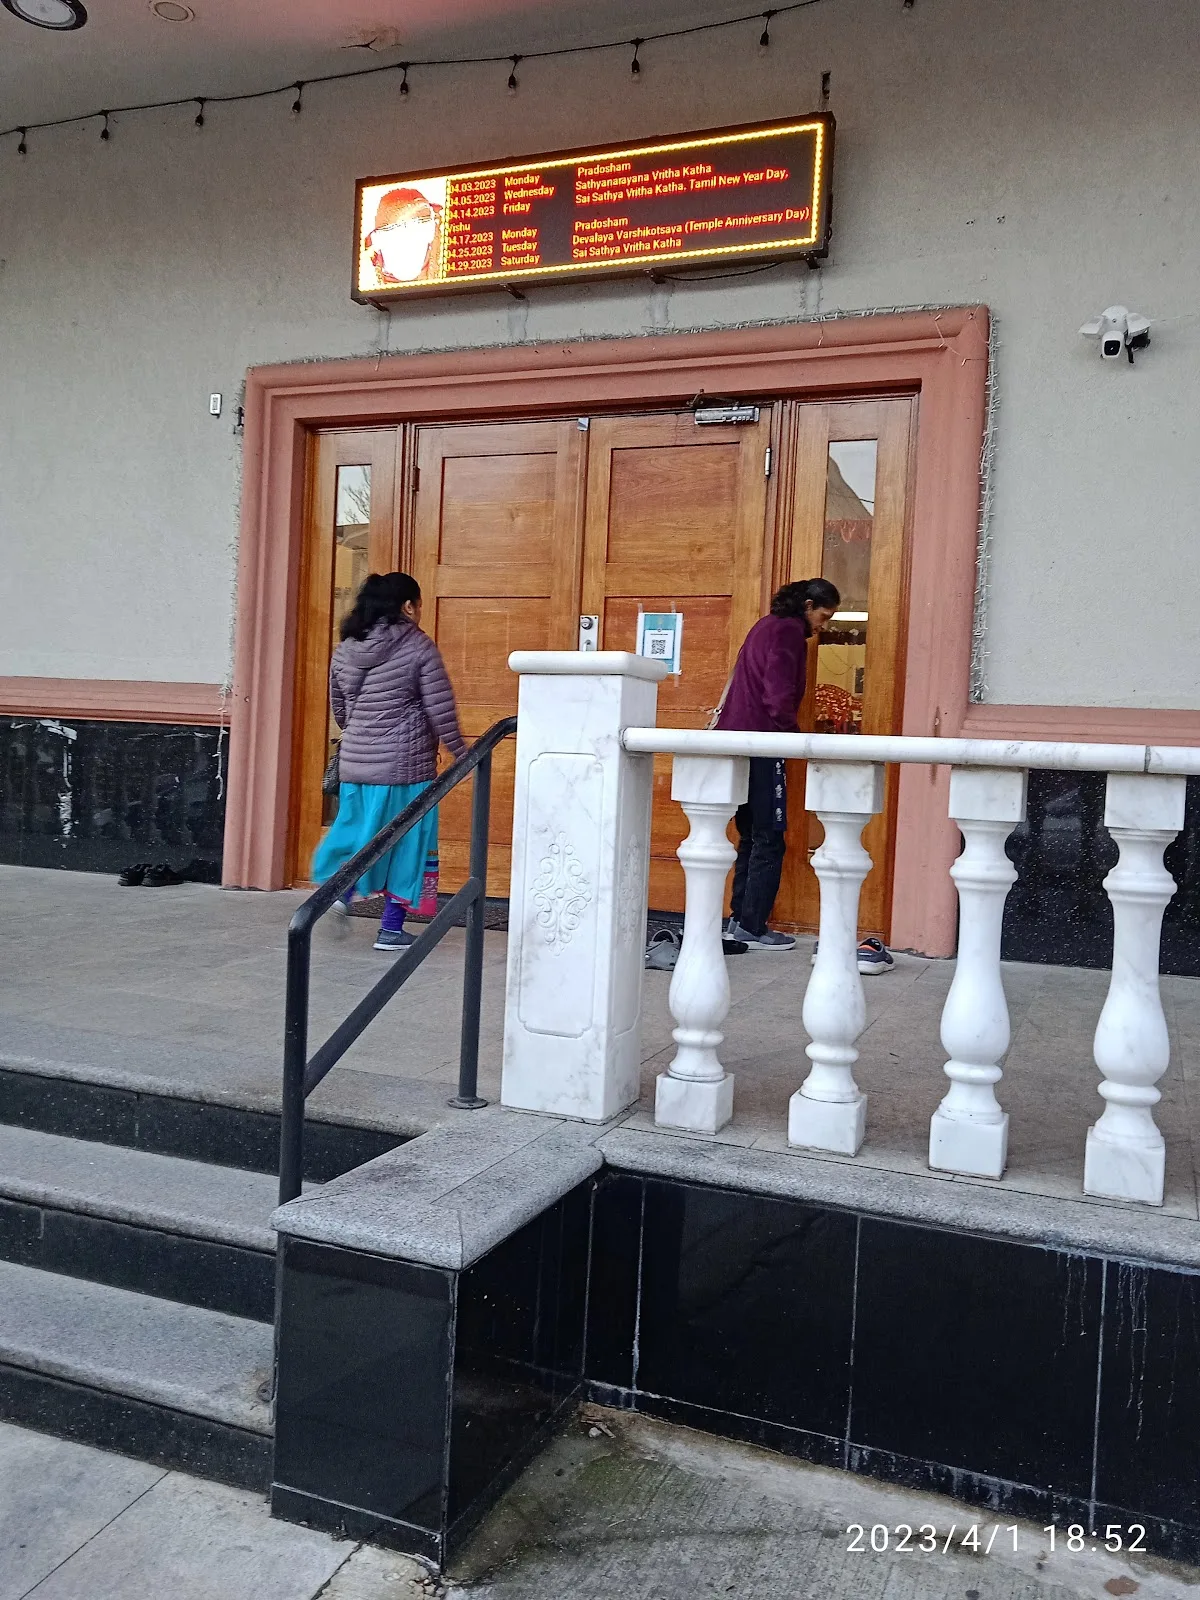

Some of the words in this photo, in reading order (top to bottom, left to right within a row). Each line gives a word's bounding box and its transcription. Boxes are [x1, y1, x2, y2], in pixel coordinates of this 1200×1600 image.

[504, 174, 540, 186] Monday
[577, 162, 631, 177] Pradosham
[504, 186, 554, 200] Wednesday
[575, 173, 649, 190] Sathyanarayana
[652, 168, 680, 181] Vritha
[682, 164, 712, 177] Katha
[503, 202, 531, 214] Friday
[575, 193, 590, 204] Sai
[592, 191, 624, 202] Sathya
[626, 186, 653, 199] Vritha
[690, 176, 716, 190] Tamil
[718, 175, 740, 186] New
[743, 172, 764, 184] Year
[766, 168, 788, 180] Day,
[502, 228, 538, 240] Monday
[574, 217, 628, 232] Pradosham
[502, 241, 538, 252] Tuesday
[572, 233, 614, 244] Devalaya
[684, 218, 724, 234] (Temple
[725, 212, 784, 227] Anniversary
[786, 207, 810, 220] Day)
[500, 254, 540, 266] Saturday
[572, 248, 588, 258] Sai
[589, 245, 620, 256] Sathya
[623, 241, 650, 254] Vritha
[652, 238, 682, 250] Katha
